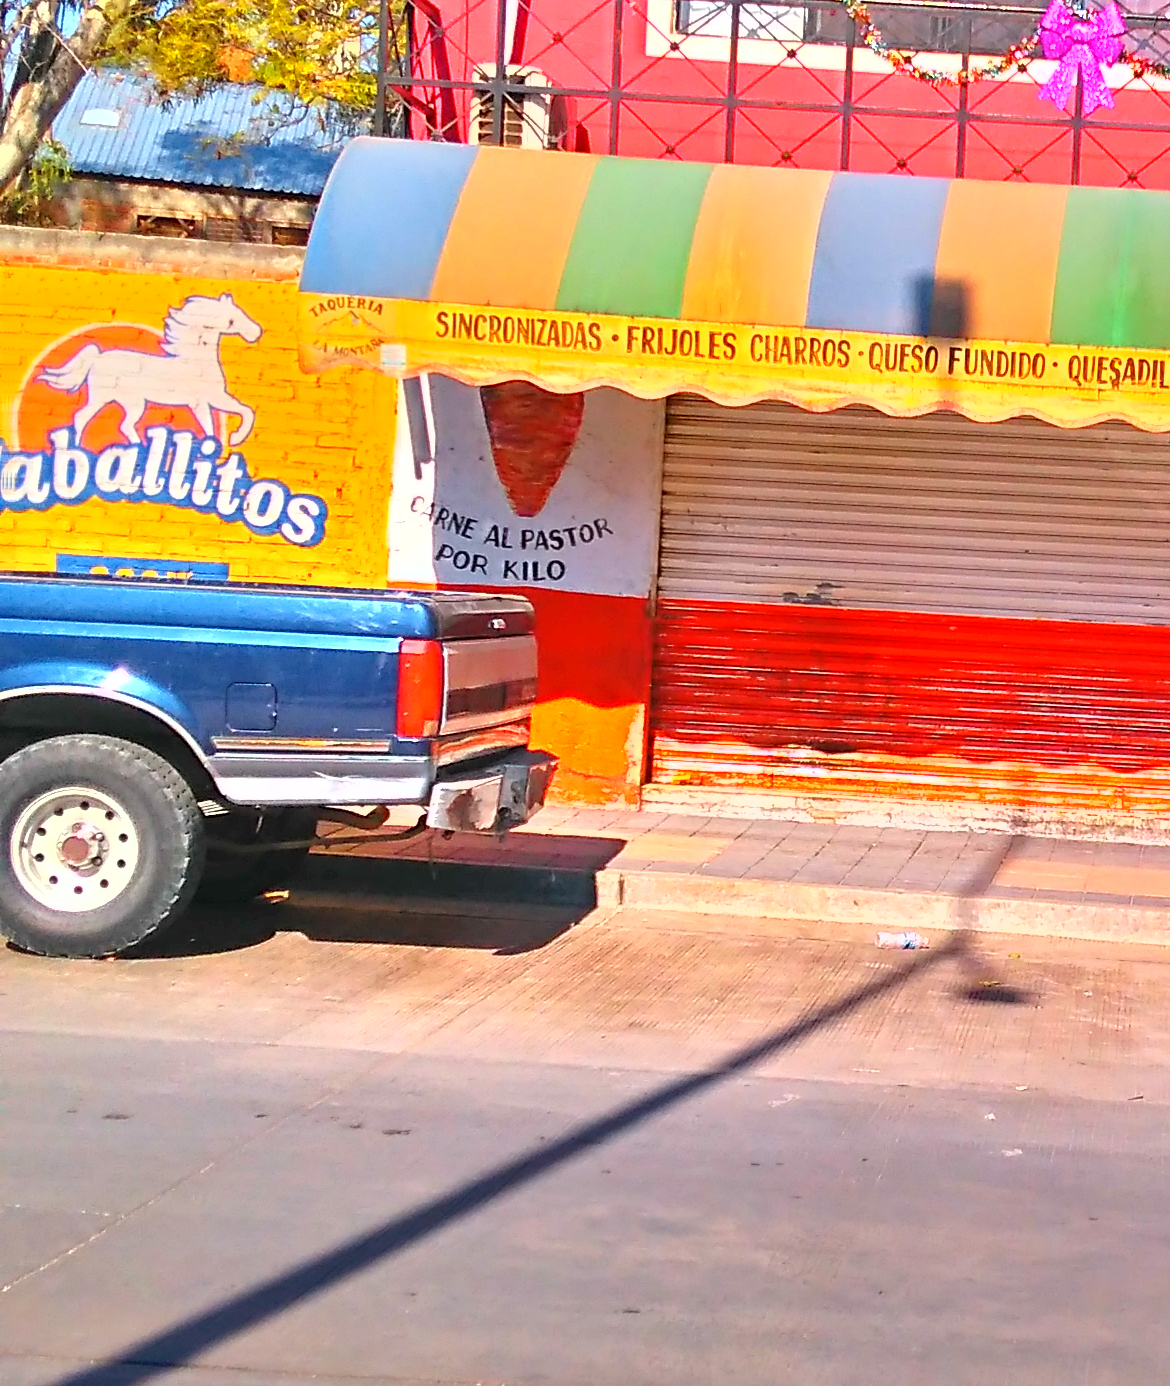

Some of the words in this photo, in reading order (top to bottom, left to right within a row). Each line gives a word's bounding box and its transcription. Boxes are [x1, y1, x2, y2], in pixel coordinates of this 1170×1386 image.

[436, 311, 601, 352] SINCRONIZADAS
[626, 325, 737, 361] FRIJOLES
[750, 333, 850, 368] CHARROS
[869, 342, 938, 374] QUESO
[948, 346, 1045, 379] FUNDIDO
[0, 425, 322, 544] aballitos
[410, 495, 479, 540] CARNE
[484, 524, 513, 549] AL
[520, 517, 614, 550] PASTOR
[435, 543, 488, 575] POR
[503, 559, 566, 581] KILO
